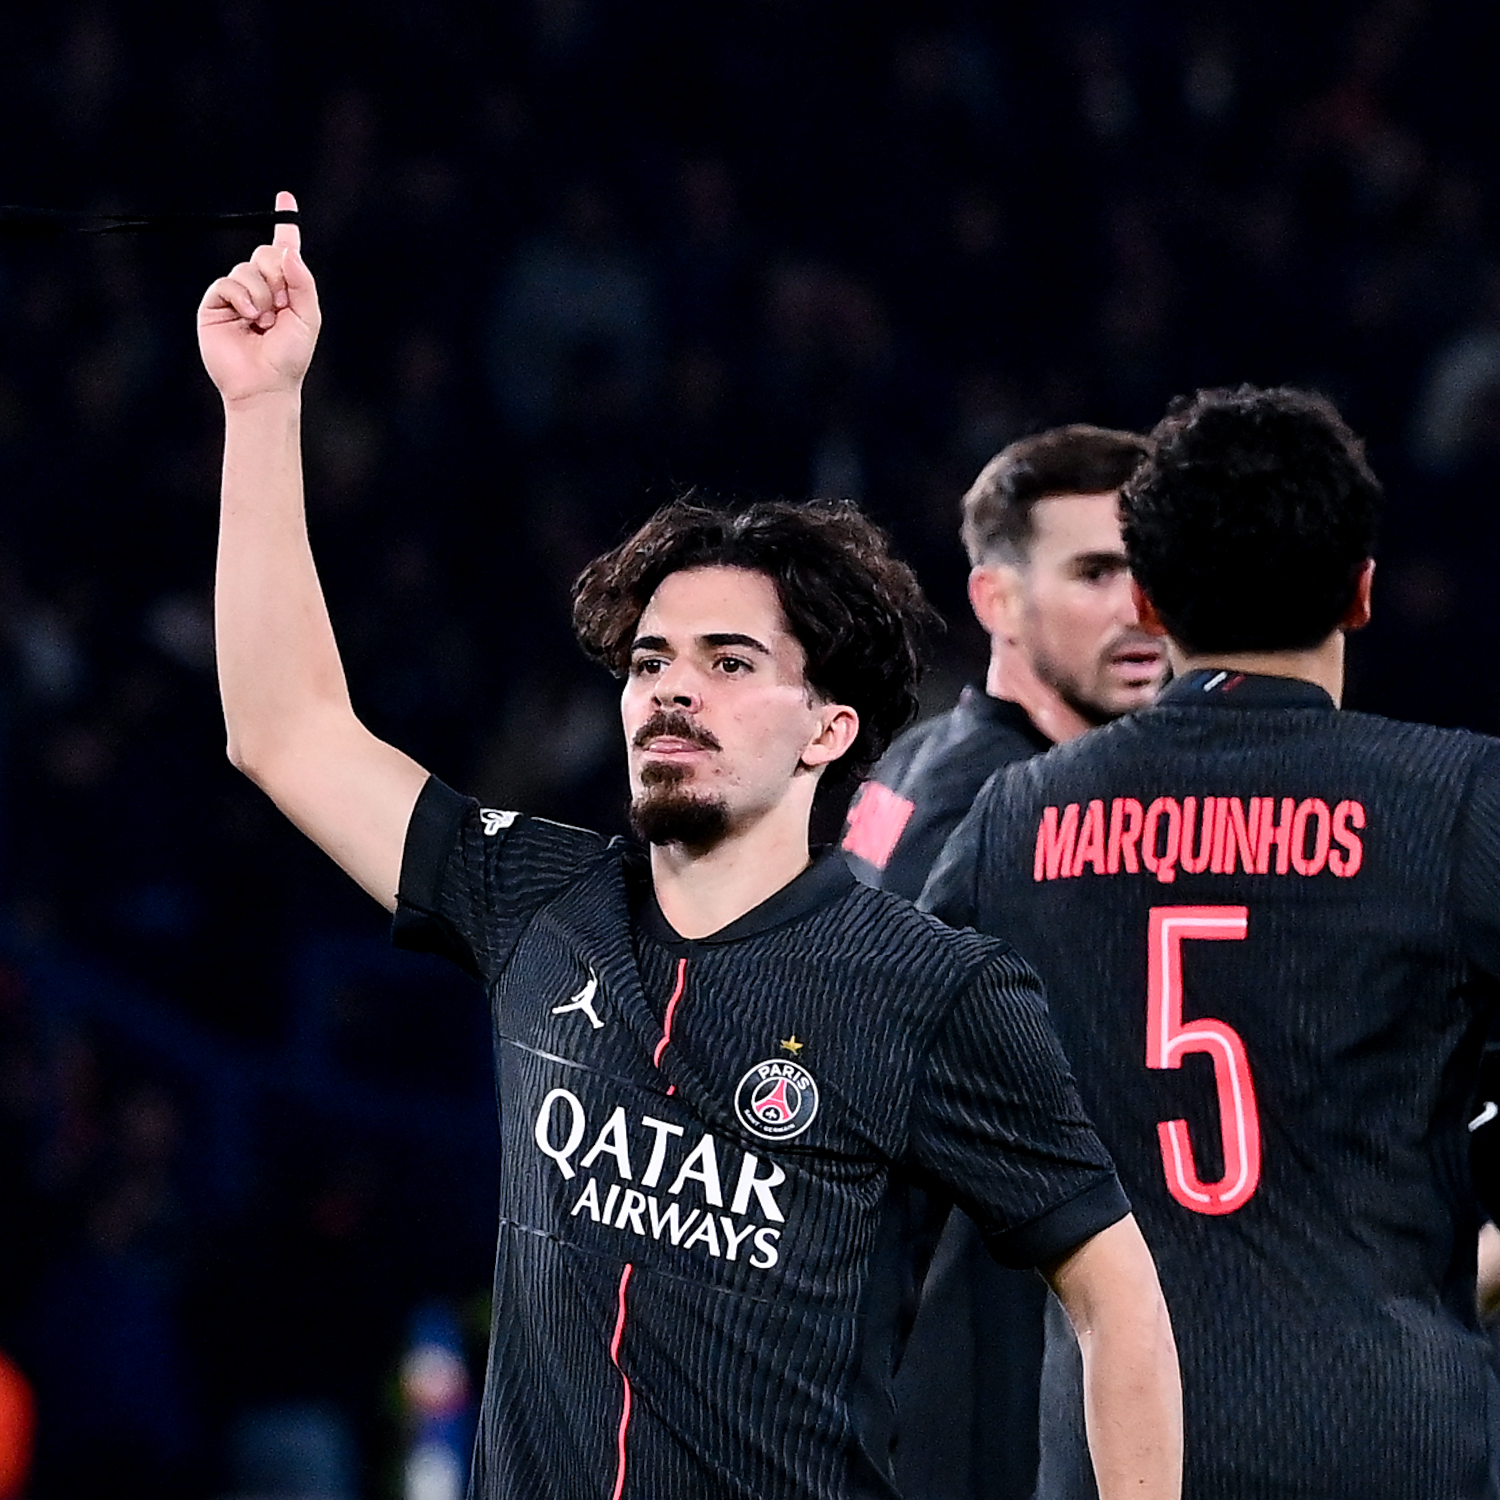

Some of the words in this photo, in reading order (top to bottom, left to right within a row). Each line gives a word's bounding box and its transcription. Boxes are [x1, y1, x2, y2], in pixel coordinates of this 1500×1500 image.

[1034, 797, 1366, 883] MARQUINHOS
[758, 1063, 810, 1091] PARIS
[1146, 905, 1261, 1216] 5
[534, 1087, 787, 1224] QATAR
[570, 1176, 782, 1270] AIRWAYS
